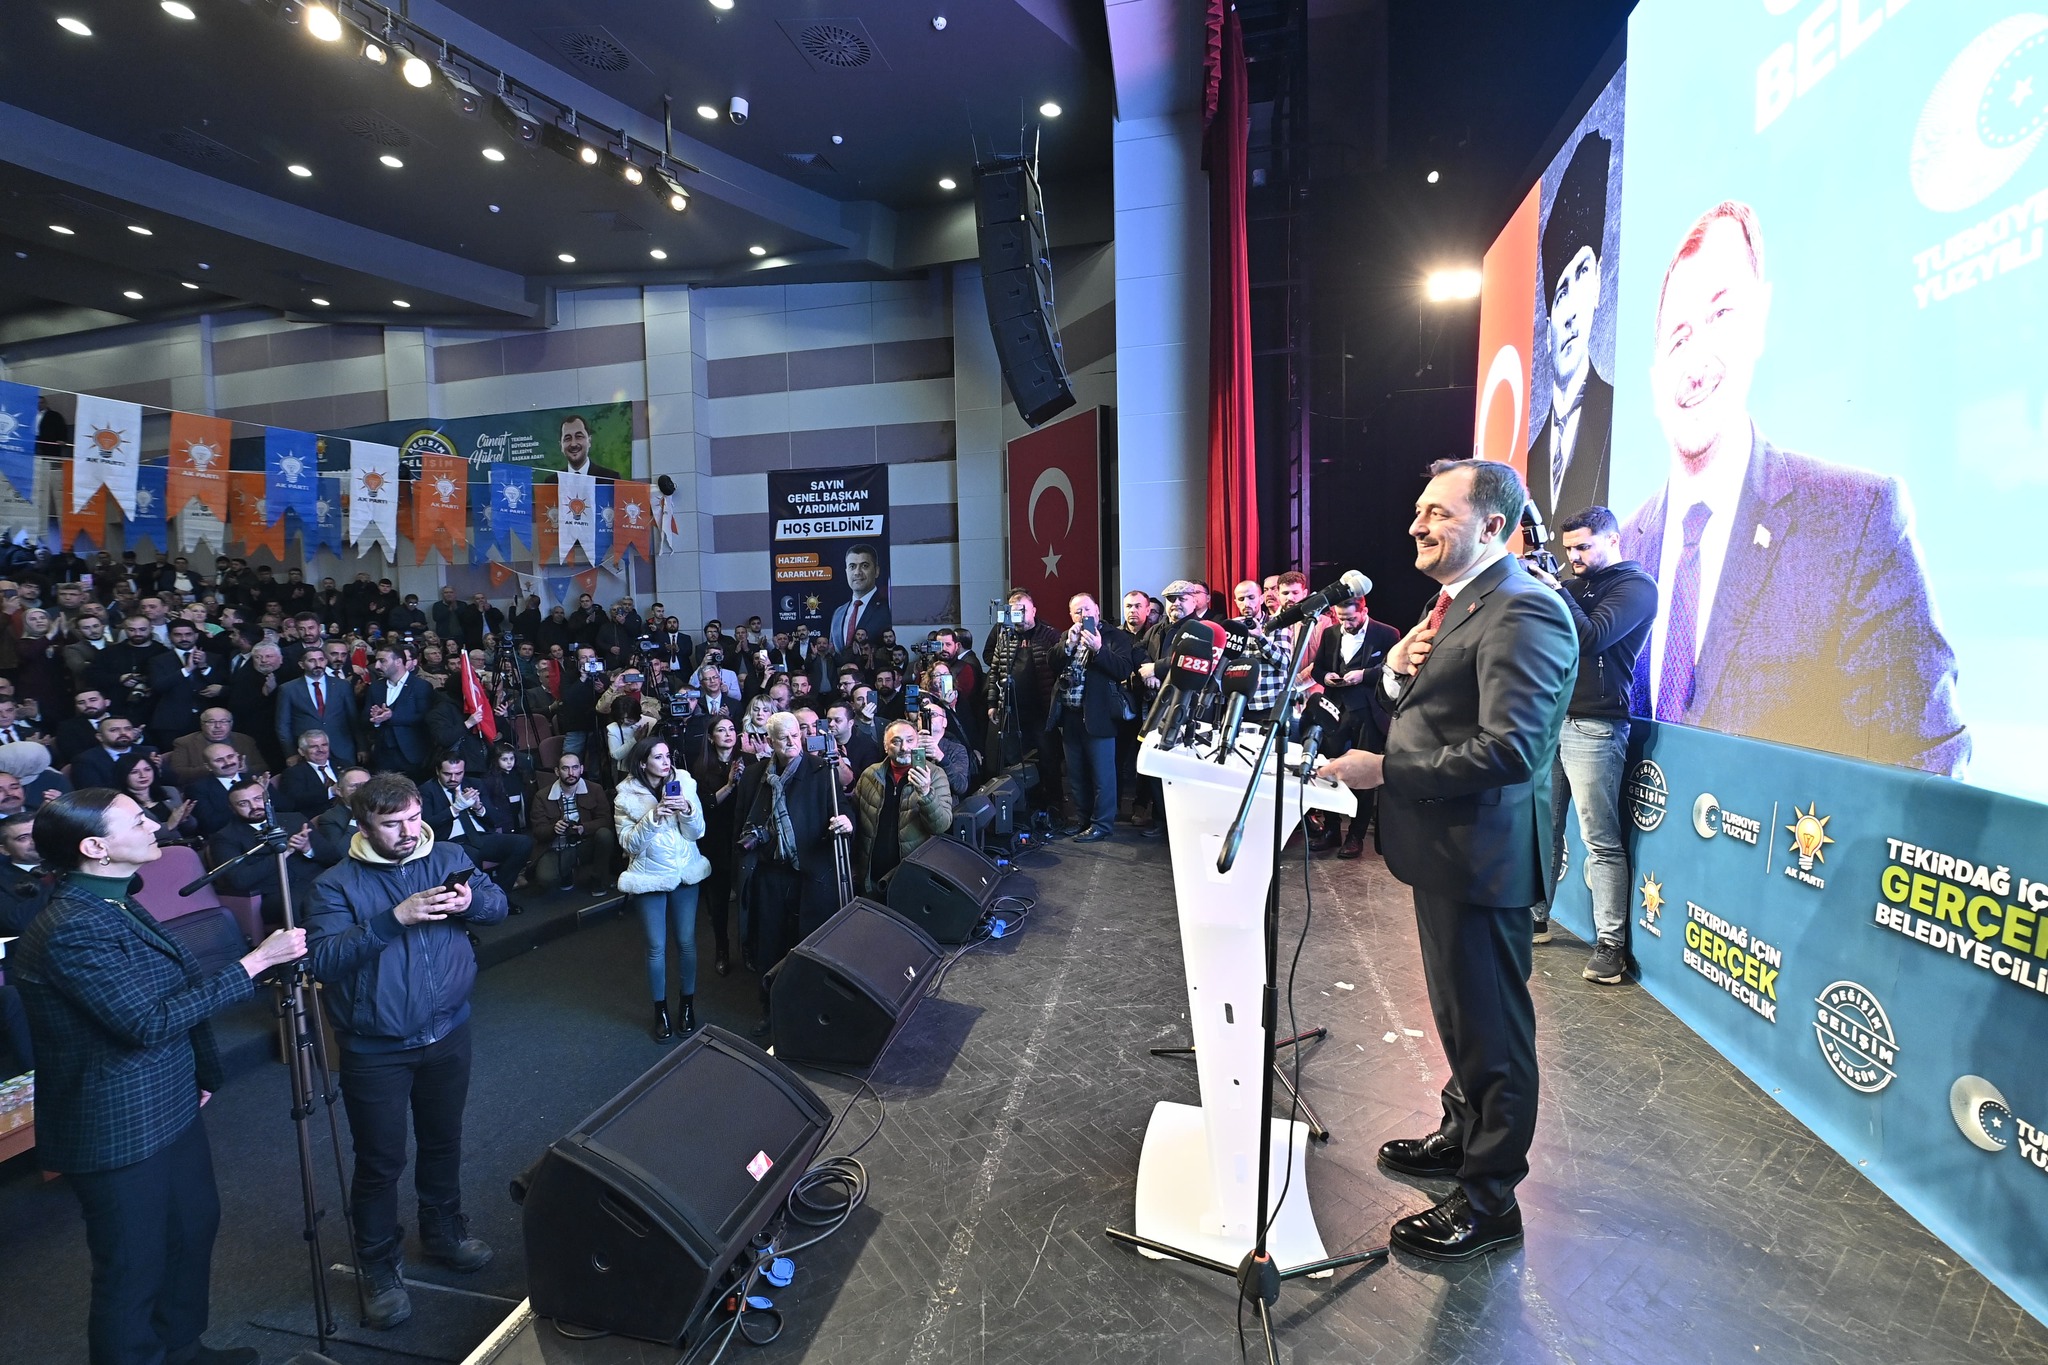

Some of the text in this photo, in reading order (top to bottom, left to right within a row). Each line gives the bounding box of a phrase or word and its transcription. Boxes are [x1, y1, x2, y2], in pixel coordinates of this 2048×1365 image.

[477, 431, 512, 451] Cüneyt
[468, 448, 505, 471] Yüksel
[810, 479, 844, 490] SAYIN
[787, 490, 868, 503] GENEL BAŞKAN
[796, 502, 860, 514] YARDIMCIM
[783, 517, 874, 536] HOŞ GELDİNİZ
[1183, 658, 1209, 672] 282
[1784, 866, 1798, 878] AK
[1886, 837, 2011, 896] TEKİRDAĞ
[1875, 902, 2048, 995] BELEDİYECİLİ
[1685, 921, 1779, 1001] GERÇEK
